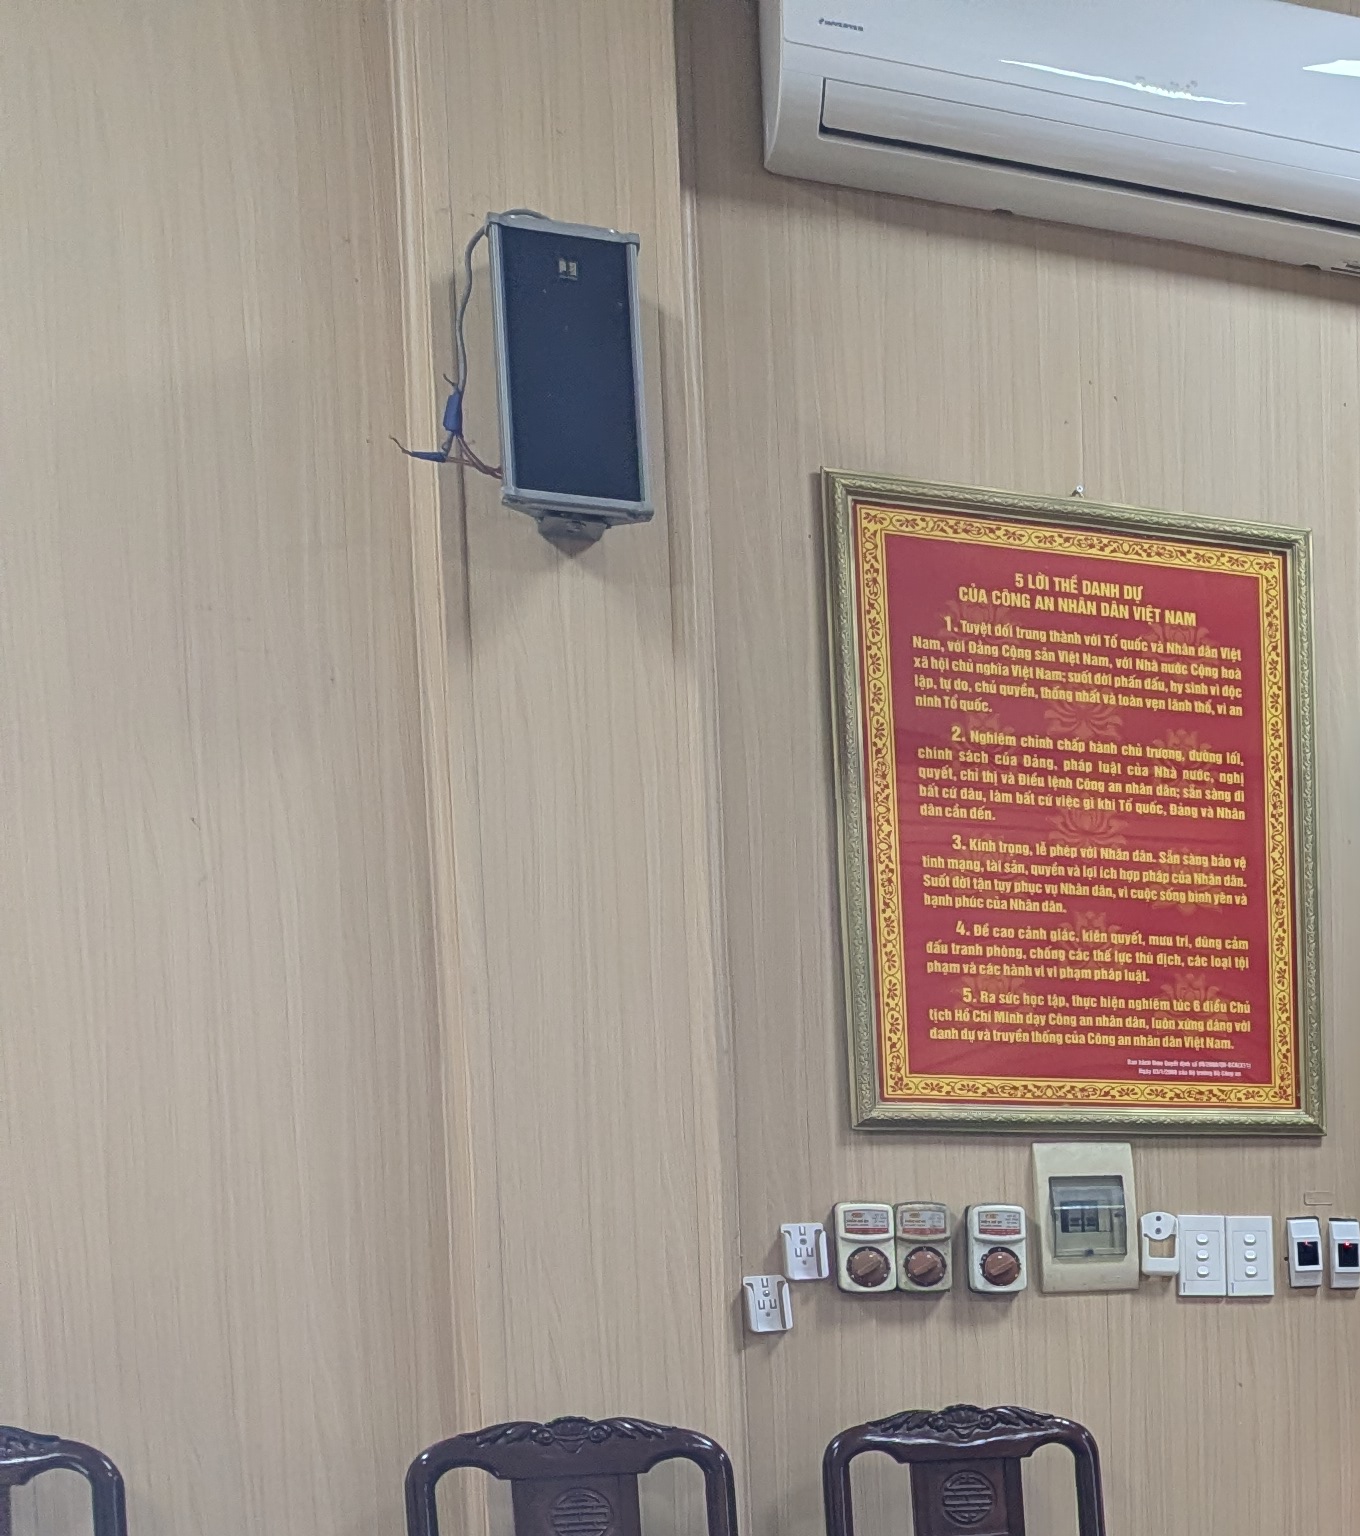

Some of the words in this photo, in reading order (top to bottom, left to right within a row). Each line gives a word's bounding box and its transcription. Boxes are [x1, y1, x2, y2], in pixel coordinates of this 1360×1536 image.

[958, 583, 988, 604] CỦA
[991, 588, 1031, 609] CÔNG
[1034, 594, 1055, 612] AN
[1057, 596, 1097, 616] NHÂN
[1100, 600, 1130, 620] DÂN
[1132, 600, 1162, 625] VIỆT
[1164, 609, 1197, 627] NAM
[1015, 572, 1024, 588] 5
[1027, 571, 1050, 591] LỜI
[1052, 575, 1079, 594] THỀ
[1081, 580, 1120, 599] DANH
[1123, 584, 1144, 602] DỰ
